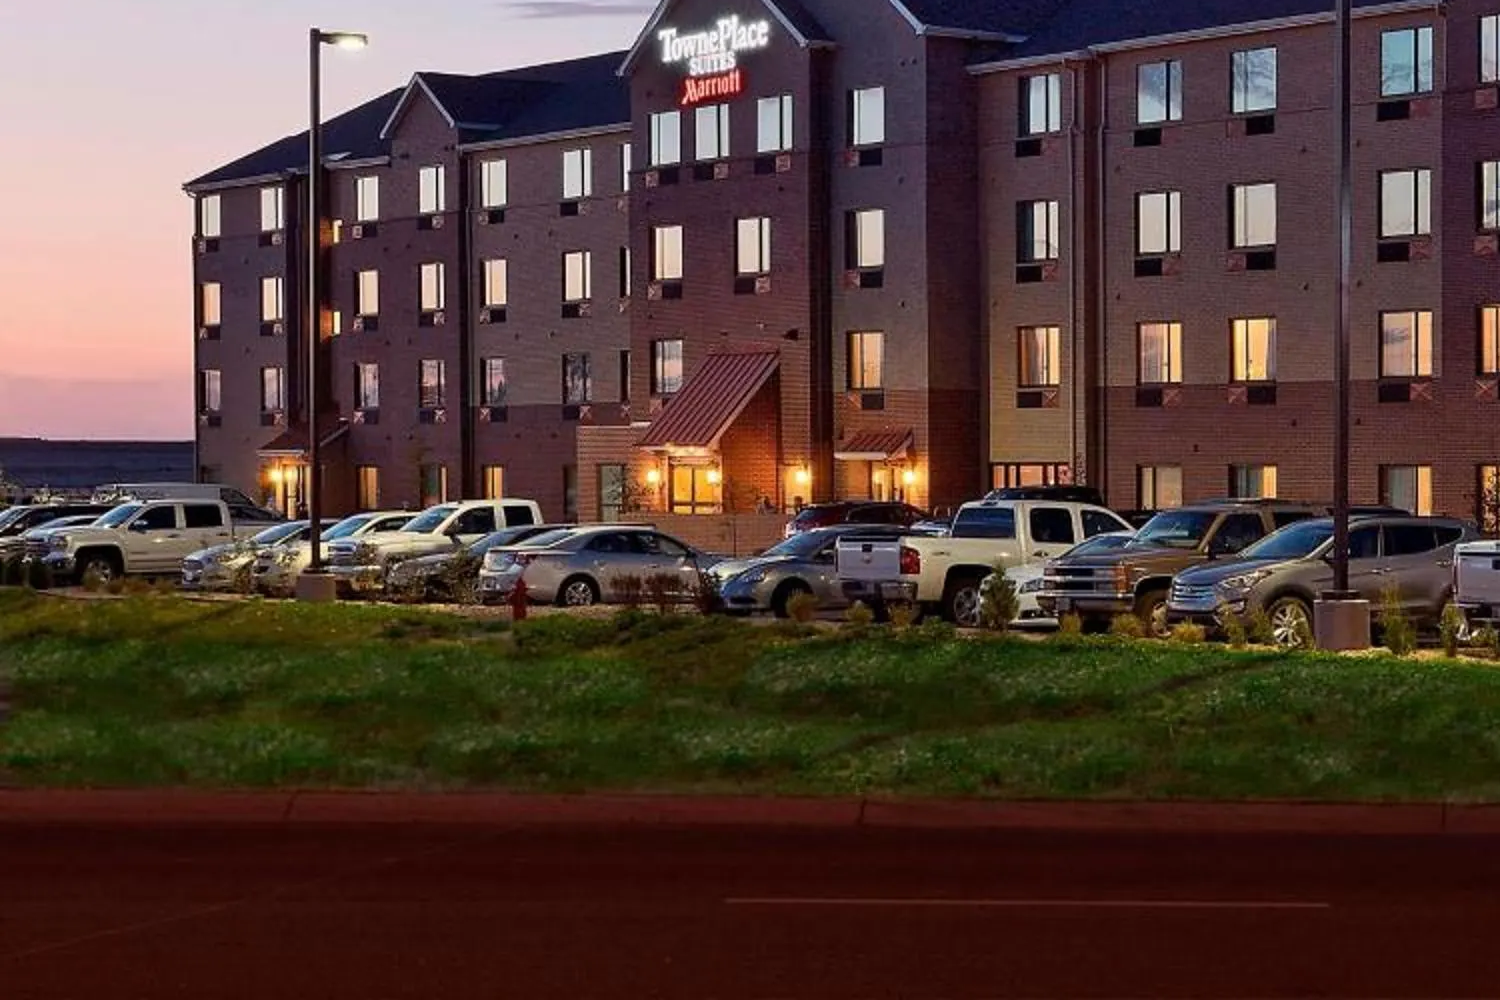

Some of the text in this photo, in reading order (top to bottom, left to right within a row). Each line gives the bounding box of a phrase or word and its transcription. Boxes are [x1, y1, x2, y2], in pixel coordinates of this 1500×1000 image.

[658, 14, 769, 63] TownePlace
[688, 50, 736, 76] SUITES
[681, 69, 741, 104] Marriott
